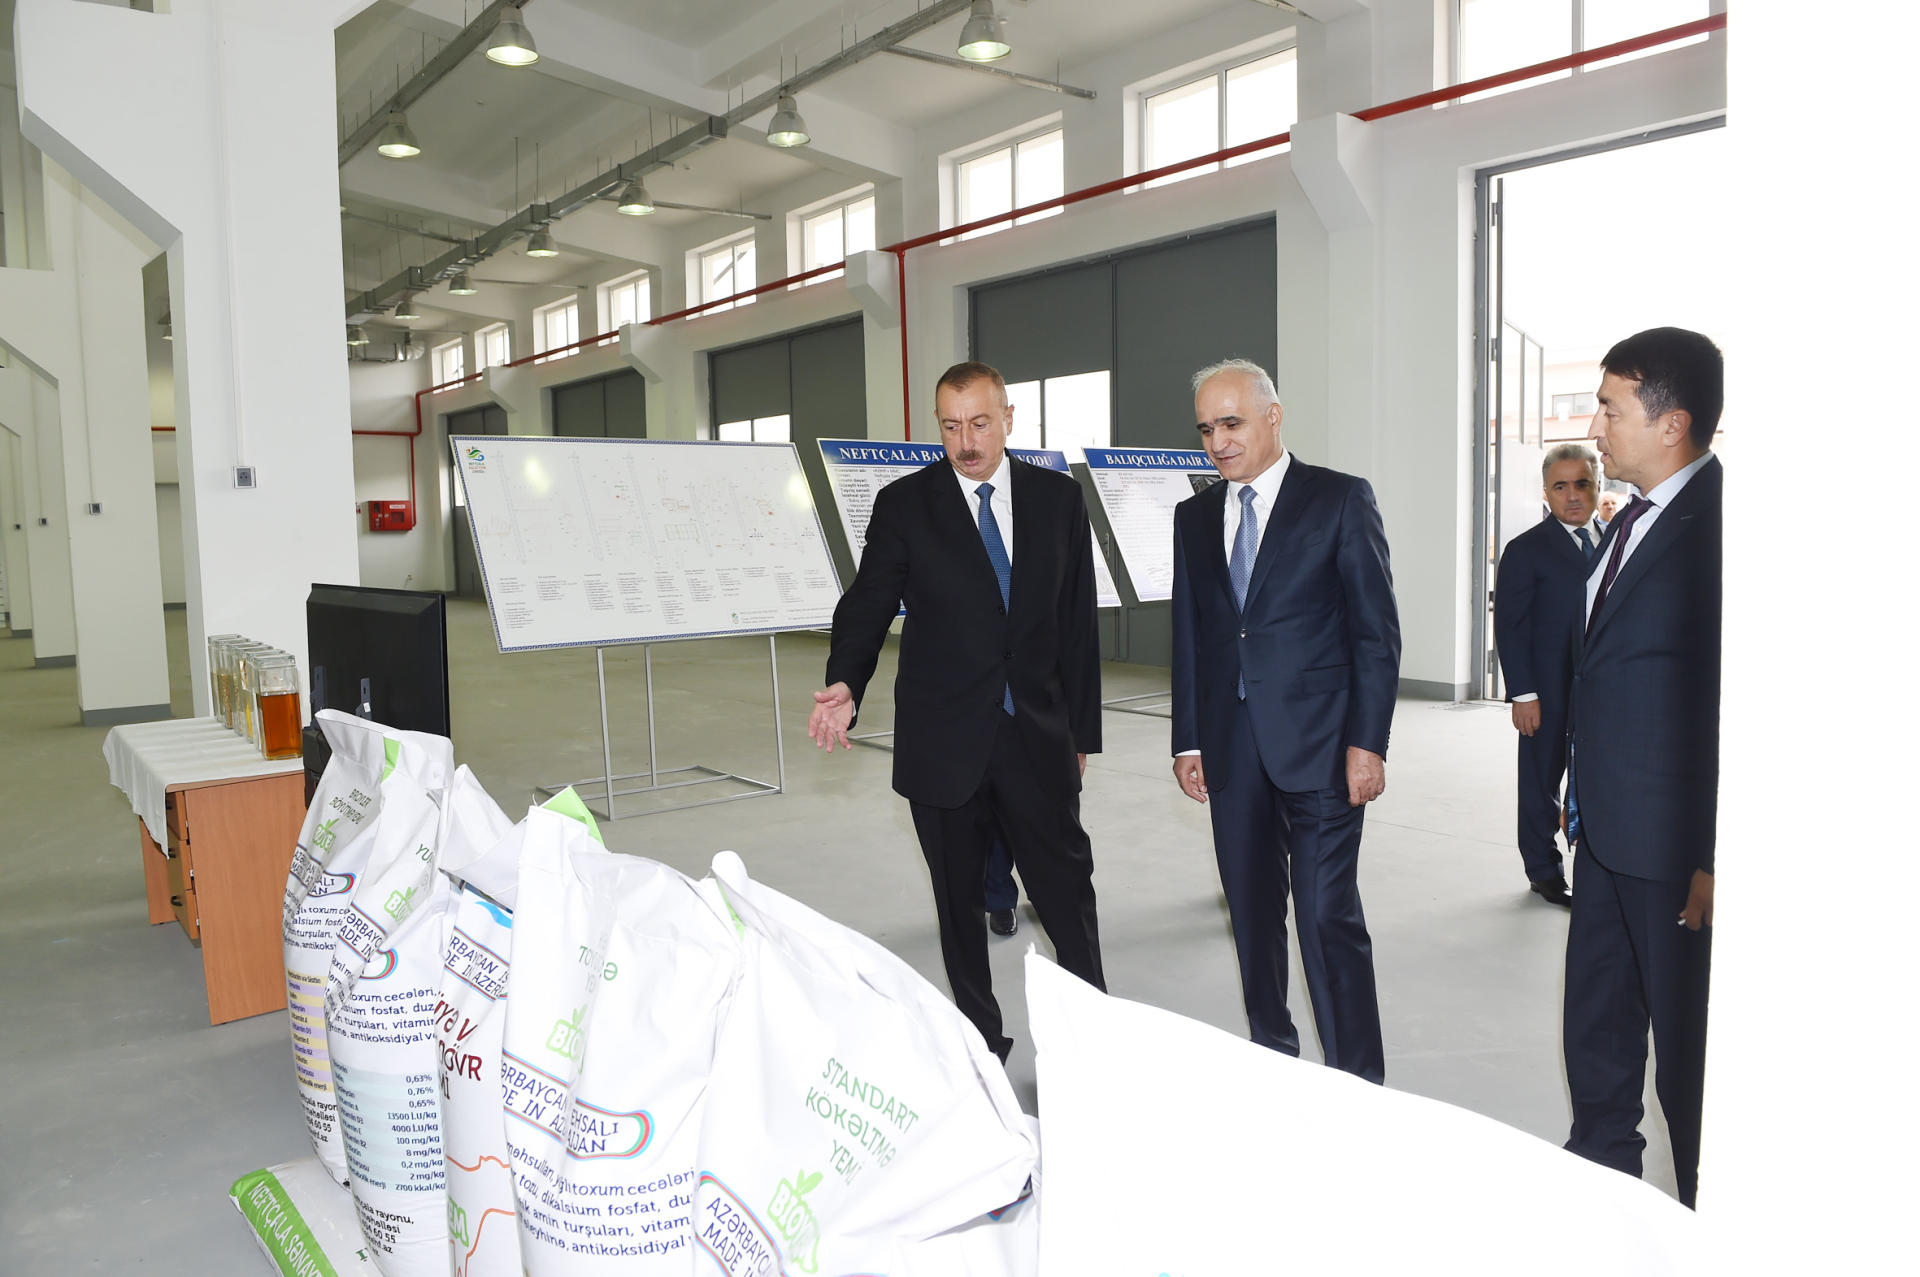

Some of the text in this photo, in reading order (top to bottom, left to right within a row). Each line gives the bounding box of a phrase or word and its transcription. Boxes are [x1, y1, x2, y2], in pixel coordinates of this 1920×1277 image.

[839, 447, 920, 462] NEFTÇALA
[1013, 454, 1053, 467] VODU
[1105, 453, 1178, 467] BALIQÇILIĞA
[1178, 454, 1204, 467] DAİR
[340, 924, 361, 946] ADE
[346, 913, 383, 948] ƏRBAYC
[450, 936, 499, 974] RBAYCAN
[351, 993, 382, 1002] oxum
[371, 1005, 408, 1015] fosfat,
[405, 1074, 433, 1084] 0,63%
[407, 1086, 434, 1096] 0,76%
[822, 1057, 919, 1135] STANDART
[317, 1101, 338, 1112] rayon
[409, 1099, 436, 1108] 0,65%
[522, 1098, 547, 1121] IN
[391, 1124, 411, 1133] 4000
[805, 1086, 897, 1168] KÖKƏLTMƏ
[396, 1137, 410, 1145] 100
[411, 1135, 440, 1145] mg/kg
[406, 1149, 412, 1157] 8
[413, 1147, 442, 1157] mg/kg
[414, 1159, 443, 1169] mg/kg
[416, 1171, 445, 1180] mg/kg
[571, 1182, 625, 1197] toxum
[541, 1190, 602, 1217] dikalsium
[608, 1201, 661, 1217] fosfat,
[668, 1194, 693, 1209] du
[375, 1209, 414, 1225] rayonu,
[563, 1219, 635, 1239] turşuları,
[641, 1216, 690, 1235] vitam
[385, 1232, 397, 1244] 55
[571, 1234, 685, 1257] antikoksidiyal
[702, 1222, 743, 1272] MADE
